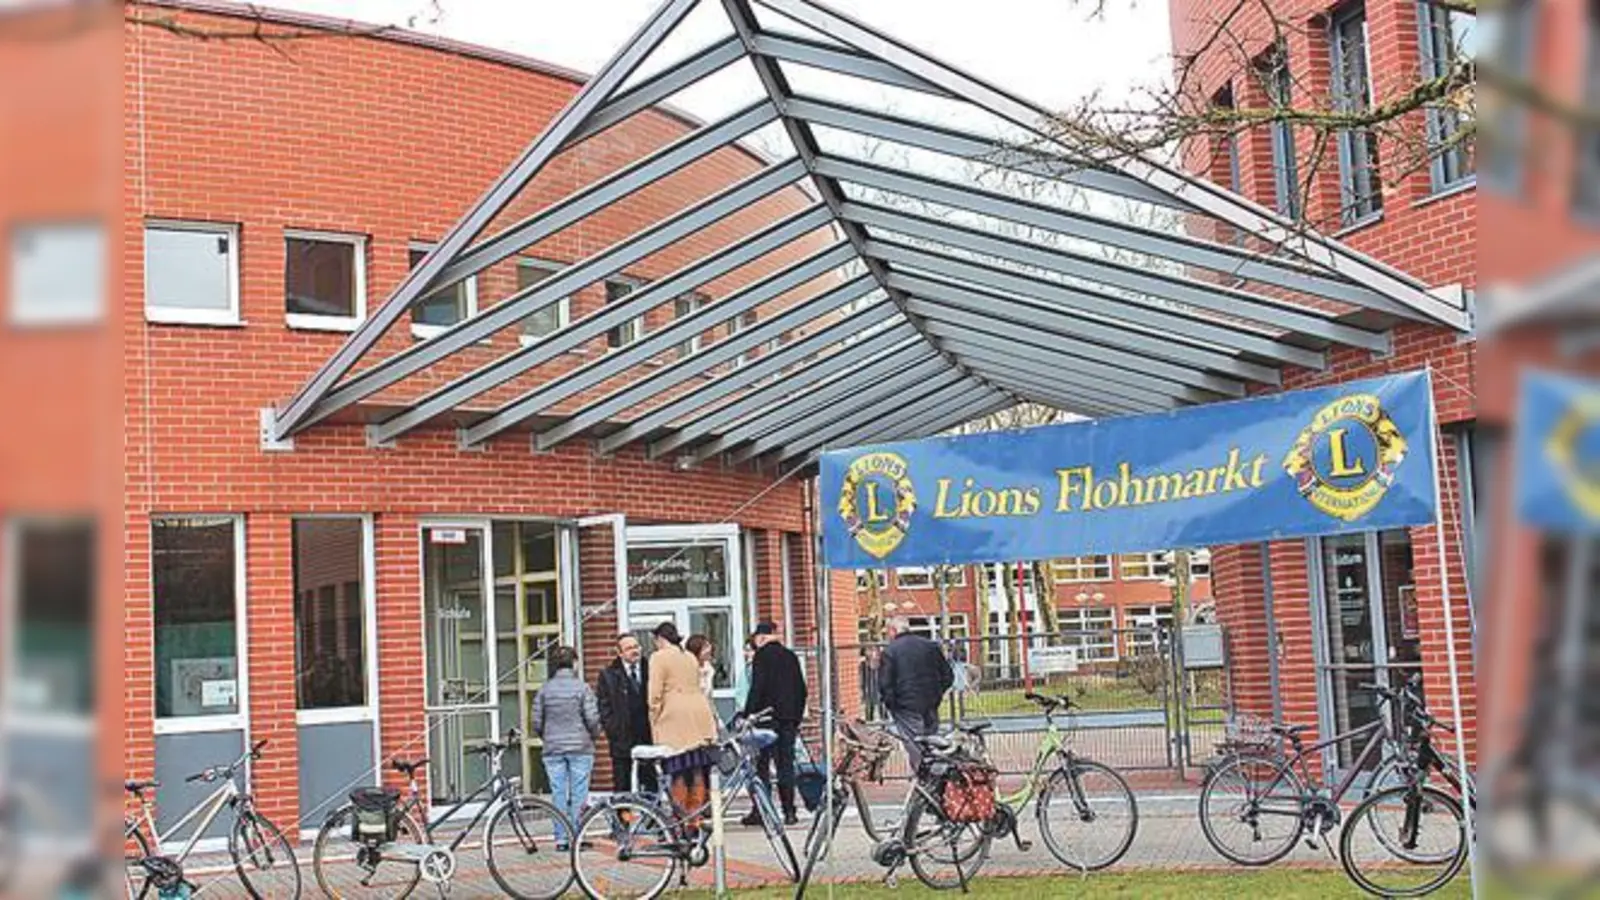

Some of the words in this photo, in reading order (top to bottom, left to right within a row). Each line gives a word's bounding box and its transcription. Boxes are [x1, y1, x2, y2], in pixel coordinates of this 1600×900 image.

[1314, 398, 1375, 426] LIONS
[855, 455, 904, 476] LIONS
[1327, 428, 1367, 478] L
[864, 481, 889, 523] L
[932, 477, 1041, 519] Lions
[1054, 447, 1270, 513] Flohmarkt
